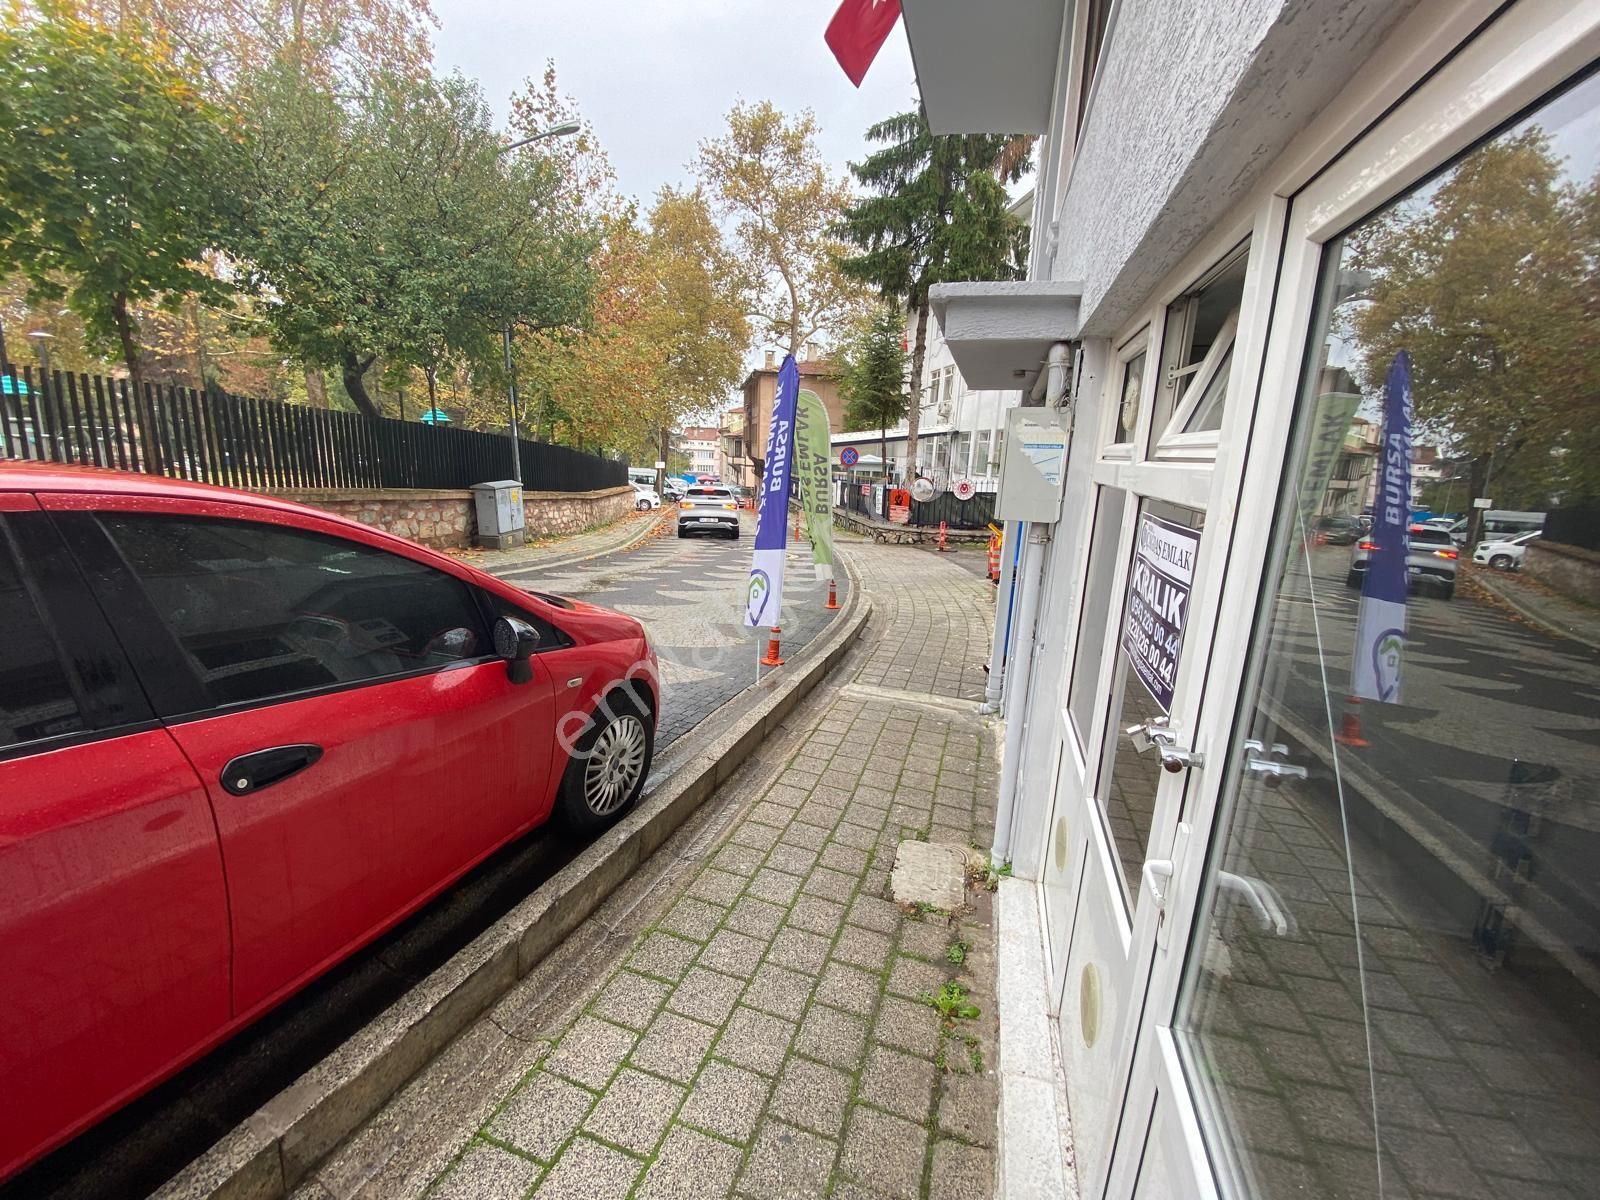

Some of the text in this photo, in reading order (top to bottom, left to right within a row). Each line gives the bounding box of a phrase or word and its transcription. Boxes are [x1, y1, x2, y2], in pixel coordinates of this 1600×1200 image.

[1384, 433, 1402, 526] BURSA
[1161, 541, 1192, 572] EMLAK
[1142, 609, 1154, 635] 226
[1154, 622, 1165, 646] 00
[1164, 634, 1178, 659] 44
[1148, 644, 1160, 669] 00
[1159, 657, 1173, 683] 44
